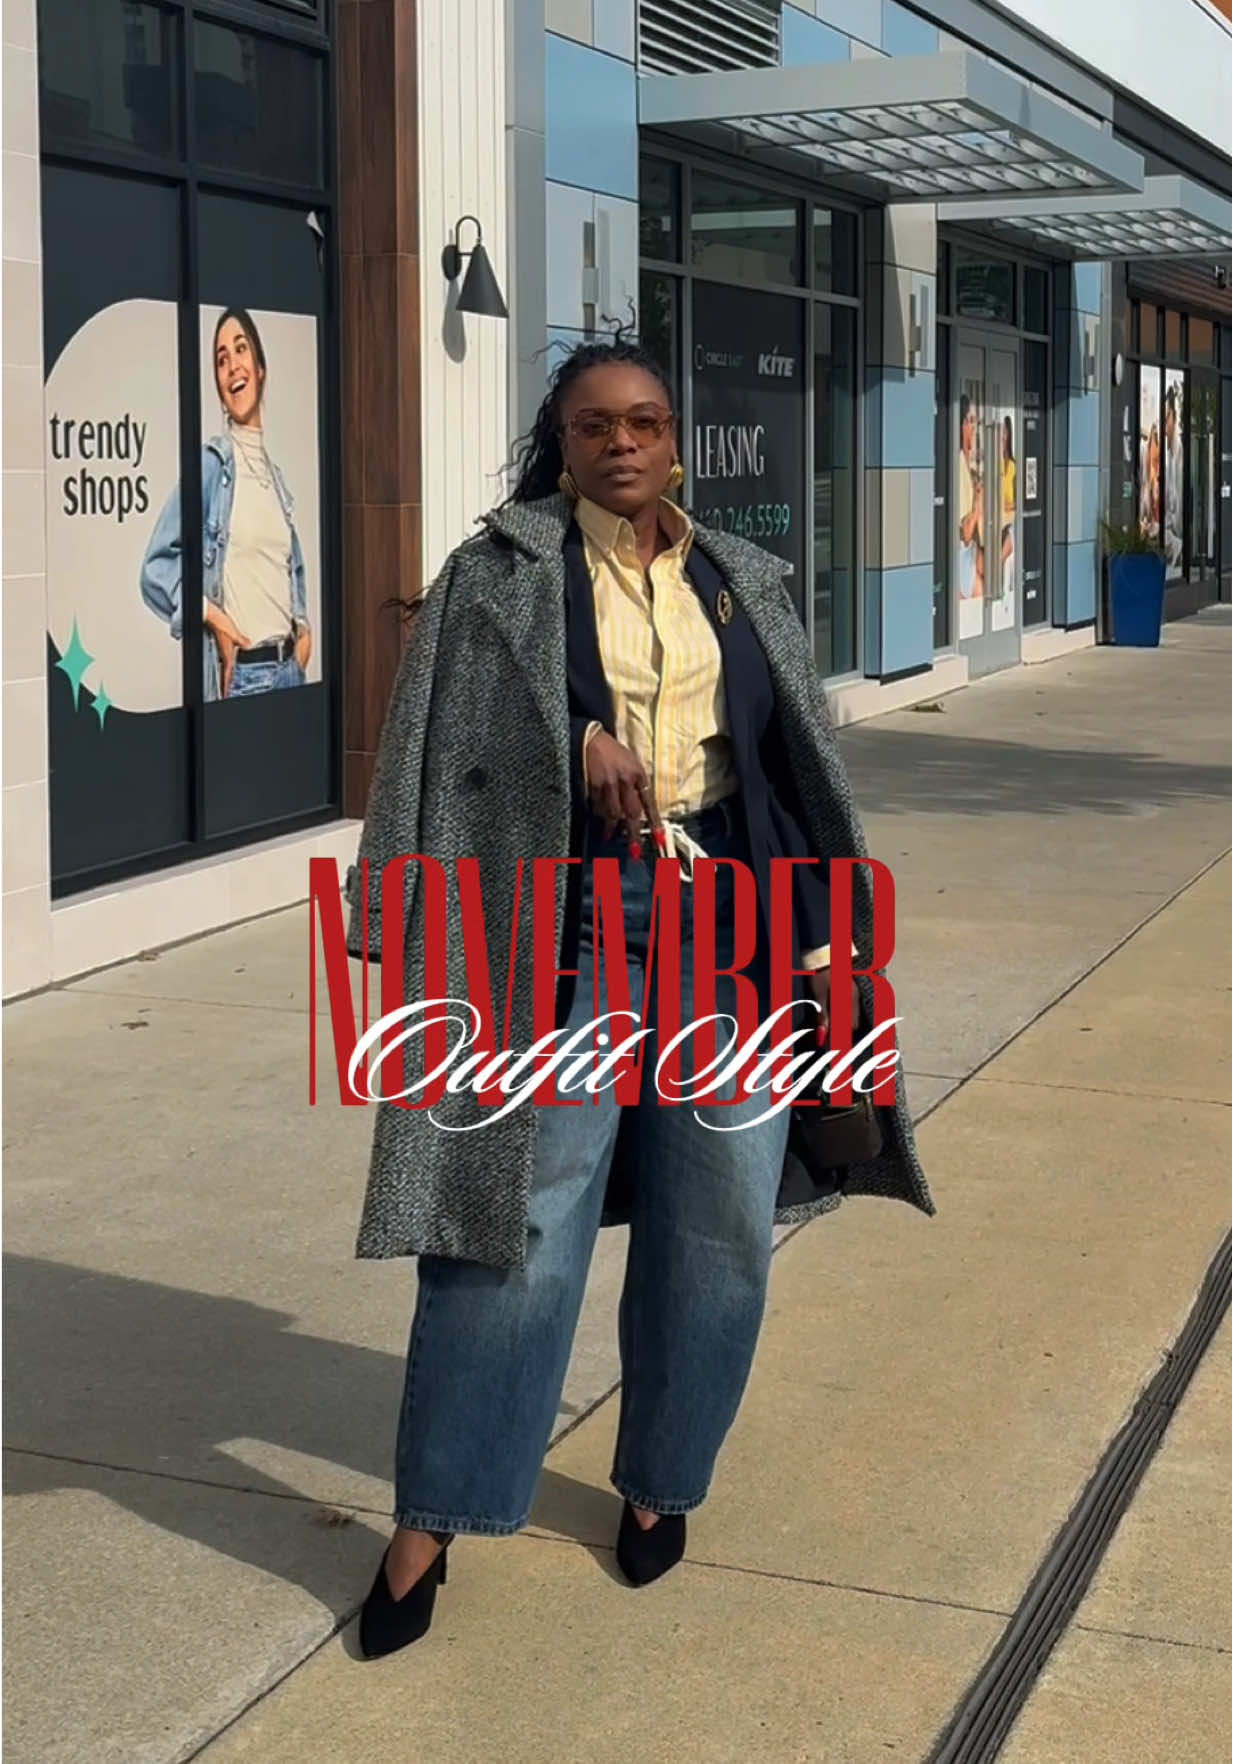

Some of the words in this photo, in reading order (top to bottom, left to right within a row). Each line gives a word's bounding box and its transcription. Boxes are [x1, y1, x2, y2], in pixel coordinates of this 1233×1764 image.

[50, 412, 146, 467] trendy
[696, 425, 765, 478] LEASING
[63, 467, 149, 523] shops
